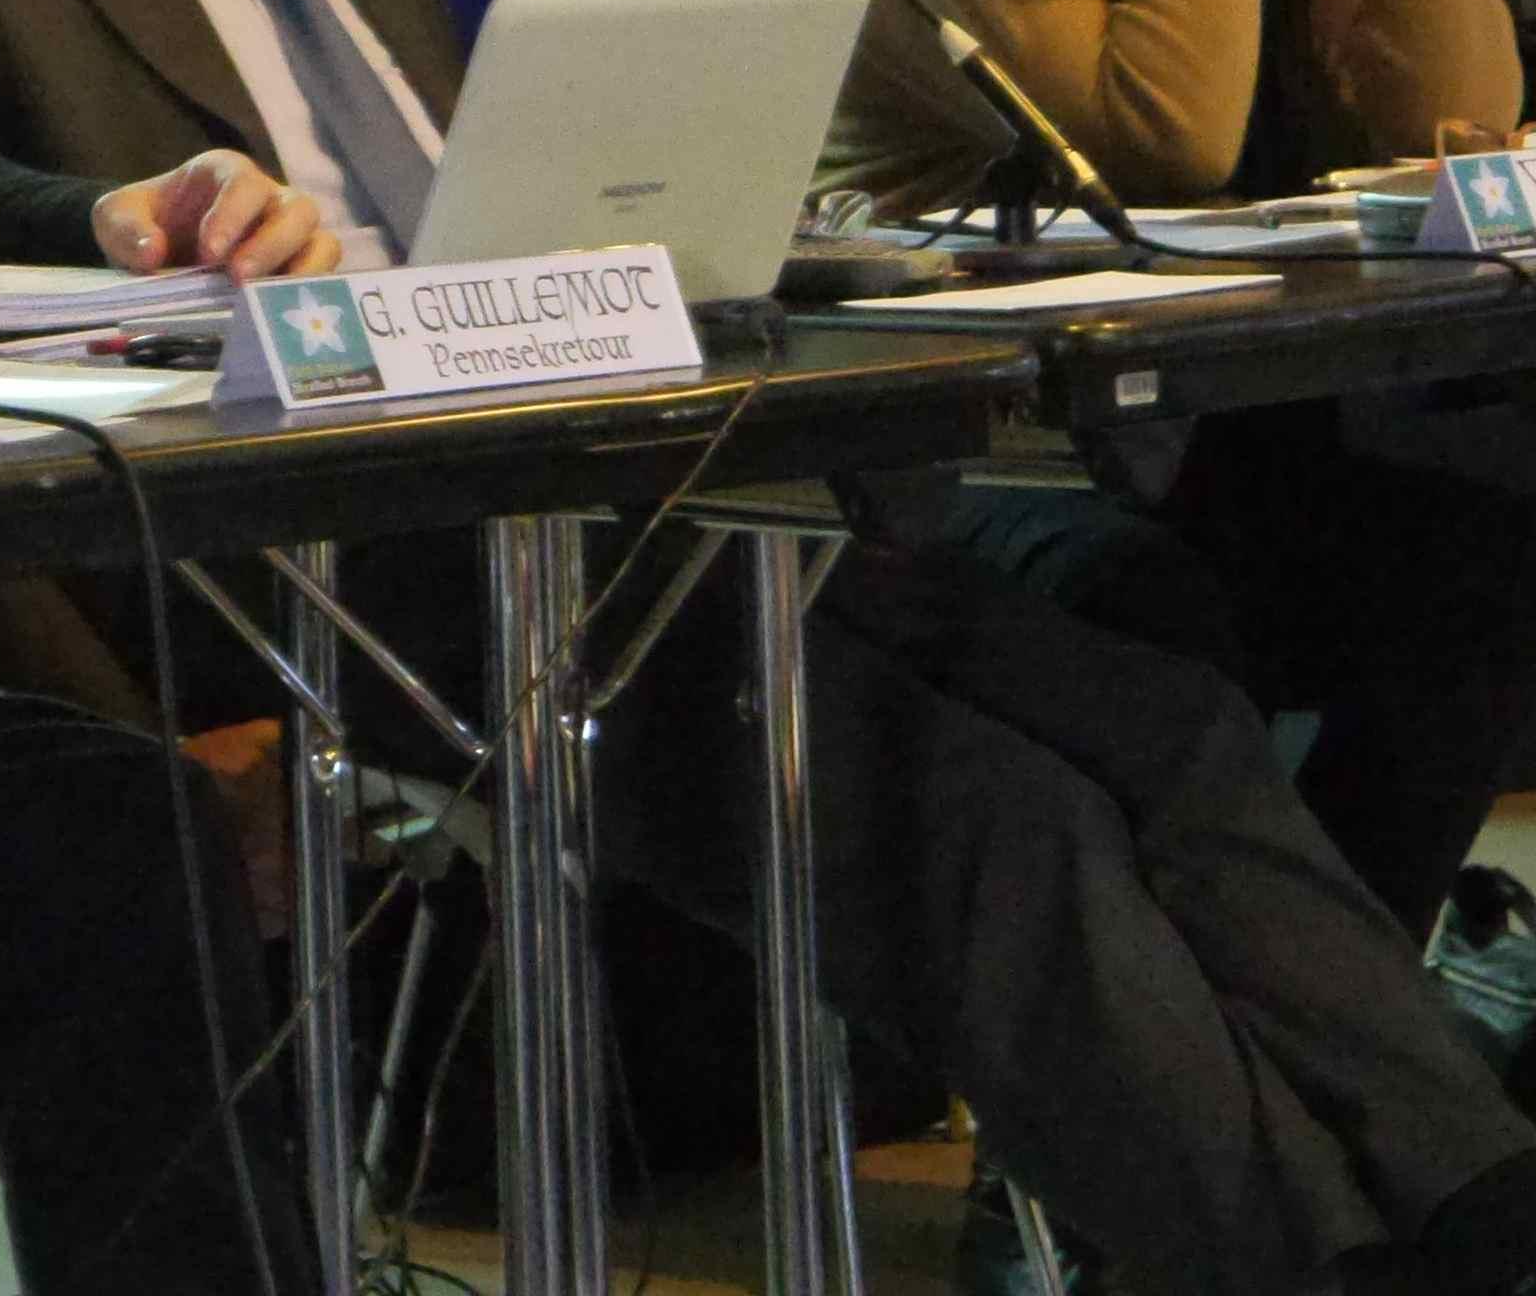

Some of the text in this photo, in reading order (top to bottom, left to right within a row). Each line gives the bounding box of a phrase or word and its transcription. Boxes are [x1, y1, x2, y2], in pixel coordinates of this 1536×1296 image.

[359, 264, 661, 339] G. GUILLEMOT
[428, 332, 634, 378] Pennsekretour
